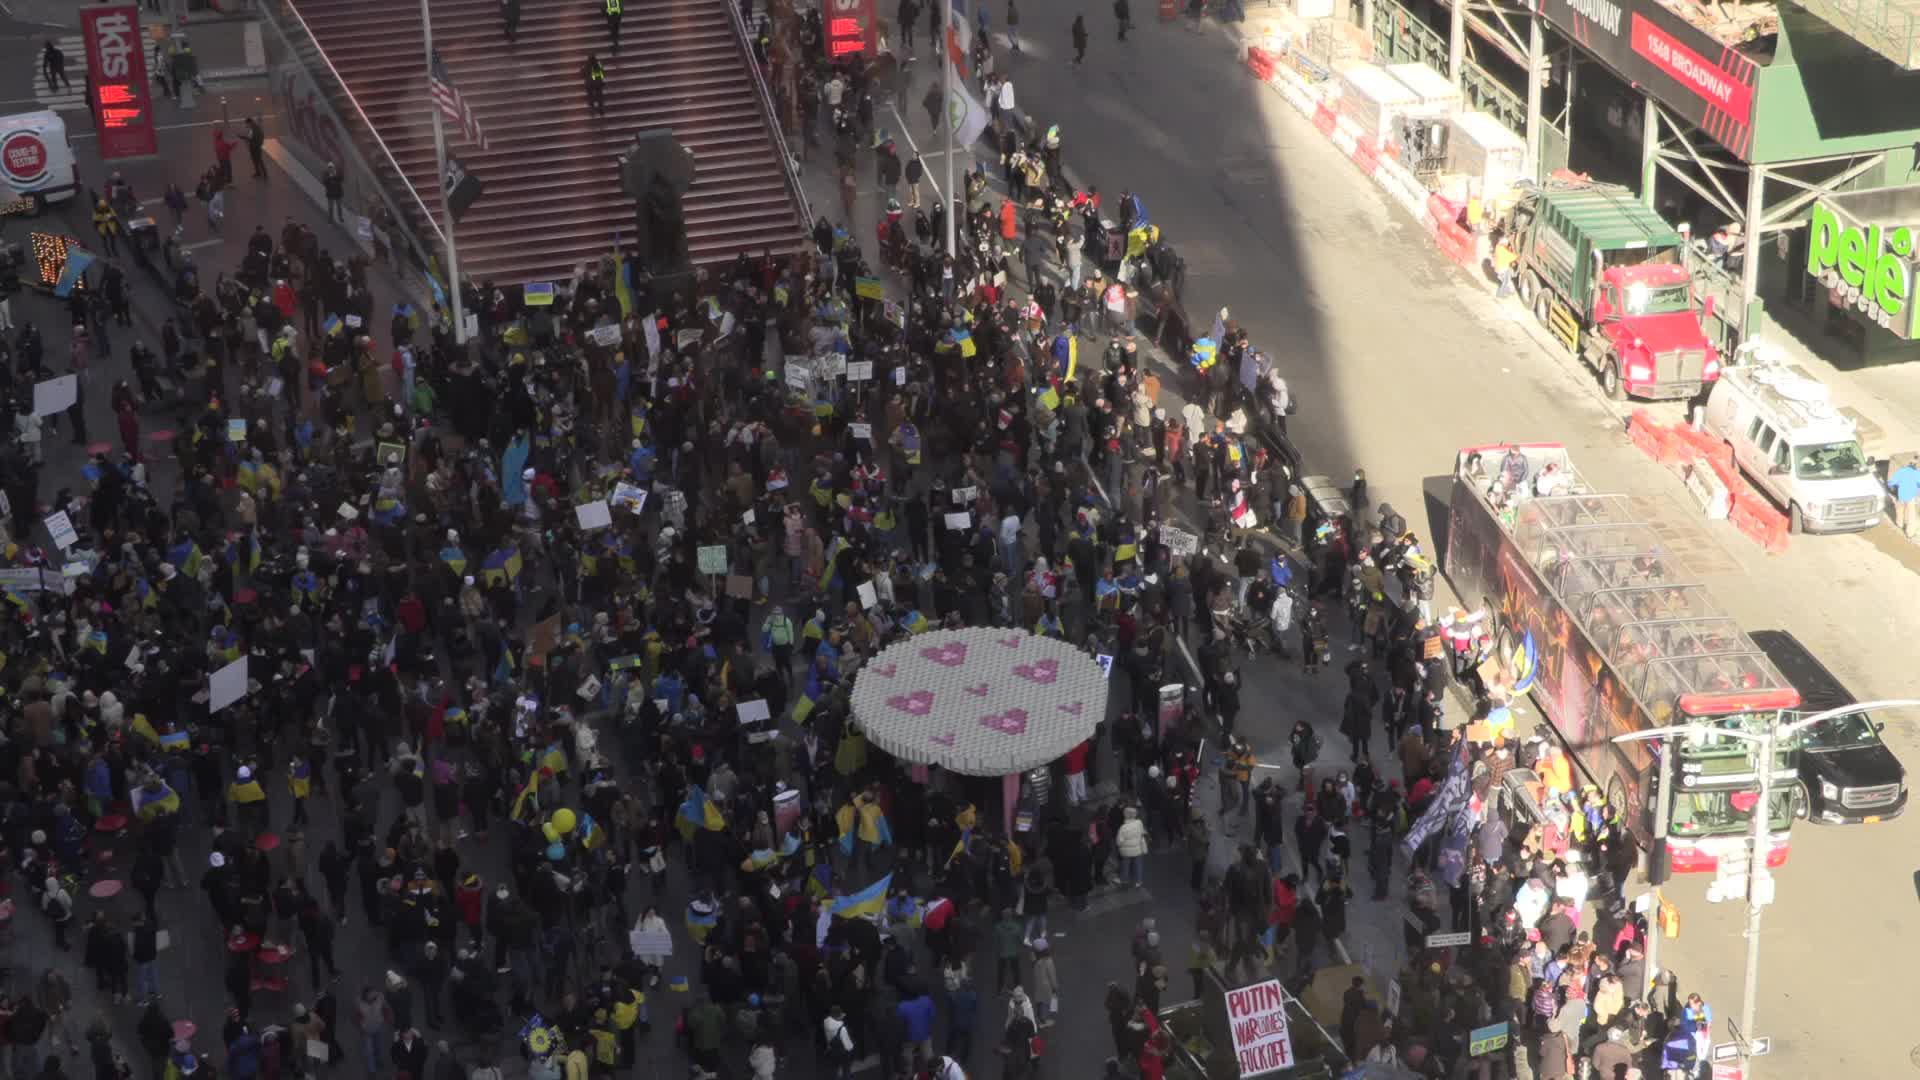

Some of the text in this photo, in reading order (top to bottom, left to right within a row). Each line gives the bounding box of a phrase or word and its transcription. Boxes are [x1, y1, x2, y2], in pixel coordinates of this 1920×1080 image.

[95, 14, 131, 78] tkts
[1648, 34, 1732, 103] 1568 BROADWAY
[1228, 983, 1281, 1018] PUTIN
[1240, 1039, 1288, 1074] FUCK OFF
